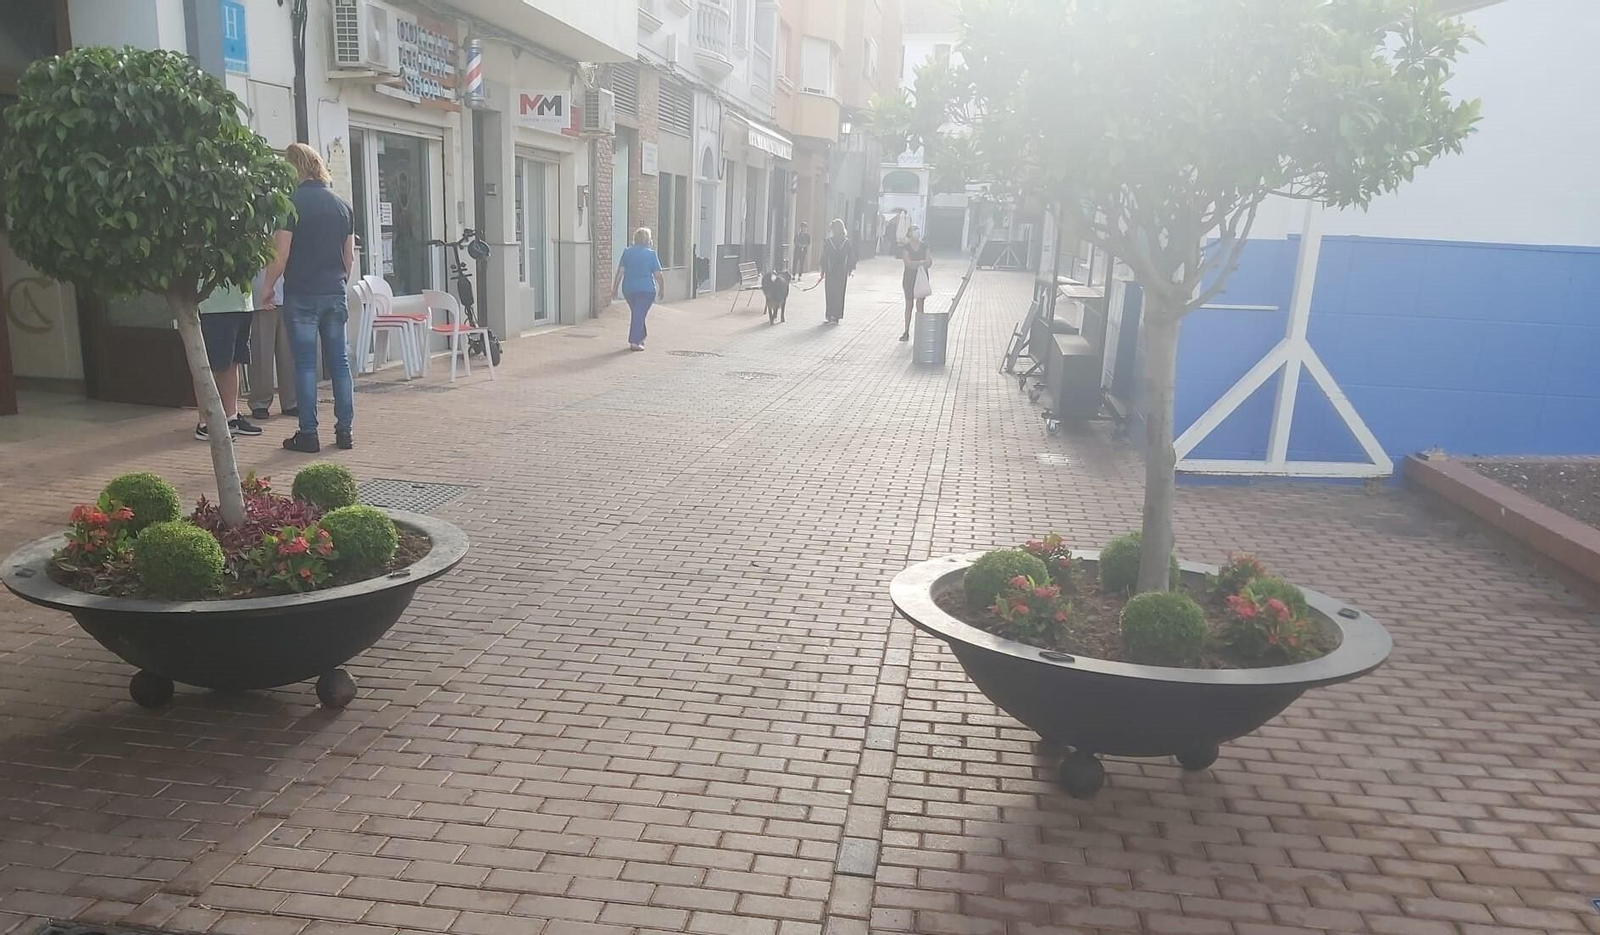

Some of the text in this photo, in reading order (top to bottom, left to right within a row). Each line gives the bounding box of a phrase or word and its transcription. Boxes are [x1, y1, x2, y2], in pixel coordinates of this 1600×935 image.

[223, 5, 238, 41] H
[400, 46, 448, 80] ARBER
[405, 74, 439, 101] SHOP
[519, 93, 563, 117] MM
